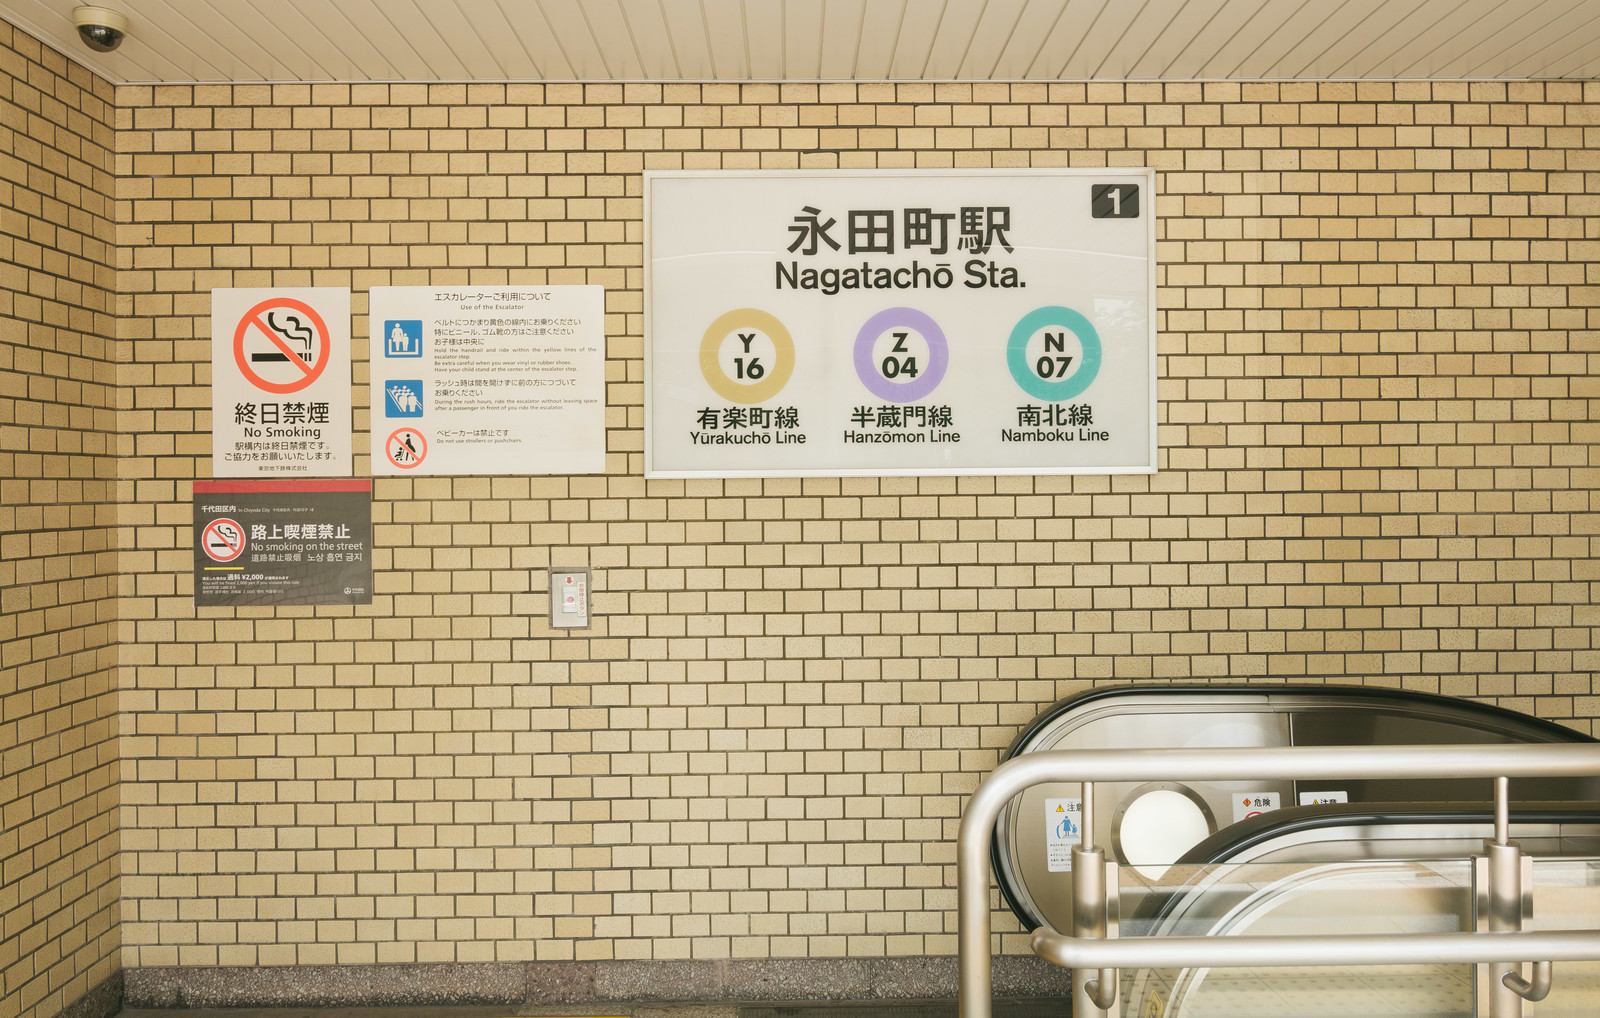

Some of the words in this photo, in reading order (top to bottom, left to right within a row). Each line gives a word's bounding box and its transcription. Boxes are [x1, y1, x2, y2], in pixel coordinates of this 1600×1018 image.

[1107, 188, 1122, 215] 1
[787, 205, 1015, 256] 永田町駅
[776, 261, 953, 295] Nagatachō
[963, 260, 1026, 289] Sta.
[434, 292, 551, 301] エスカレーターご利用について
[737, 334, 756, 353] Y
[892, 333, 909, 352] Z
[1045, 332, 1064, 352] N
[734, 357, 764, 380] 16
[882, 357, 919, 378] 04
[1037, 356, 1072, 378] 07
[235, 402, 330, 425] 終日禁煙
[696, 408, 800, 430] 有楽町線
[850, 405, 953, 428] 半蔵門線
[1016, 404, 1093, 427] 南北線
[244, 427, 262, 437] No
[266, 426, 321, 439] Smoking
[690, 430, 771, 444] Yūrakuchō
[775, 430, 806, 444] Line
[844, 430, 926, 443] Hanzōmon
[930, 429, 961, 443] Line
[1001, 428, 1075, 442] Namboku
[1079, 427, 1110, 441] Line
[235, 441, 330, 451] 駅構内は終日禁煙です。
[224, 452, 337, 461] ご協力をお願いいたします。
[251, 524, 351, 540] 路上喫煙禁止
[251, 543, 263, 551] No
[266, 542, 303, 552] smoking
[306, 542, 318, 551] on
[319, 542, 334, 551] the
[336, 542, 363, 550] street
[251, 554, 301, 562] 道路禁止吸烟
[307, 553, 324, 562] 노상
[346, 552, 363, 562] 금지
[1254, 798, 1271, 807] 危険
